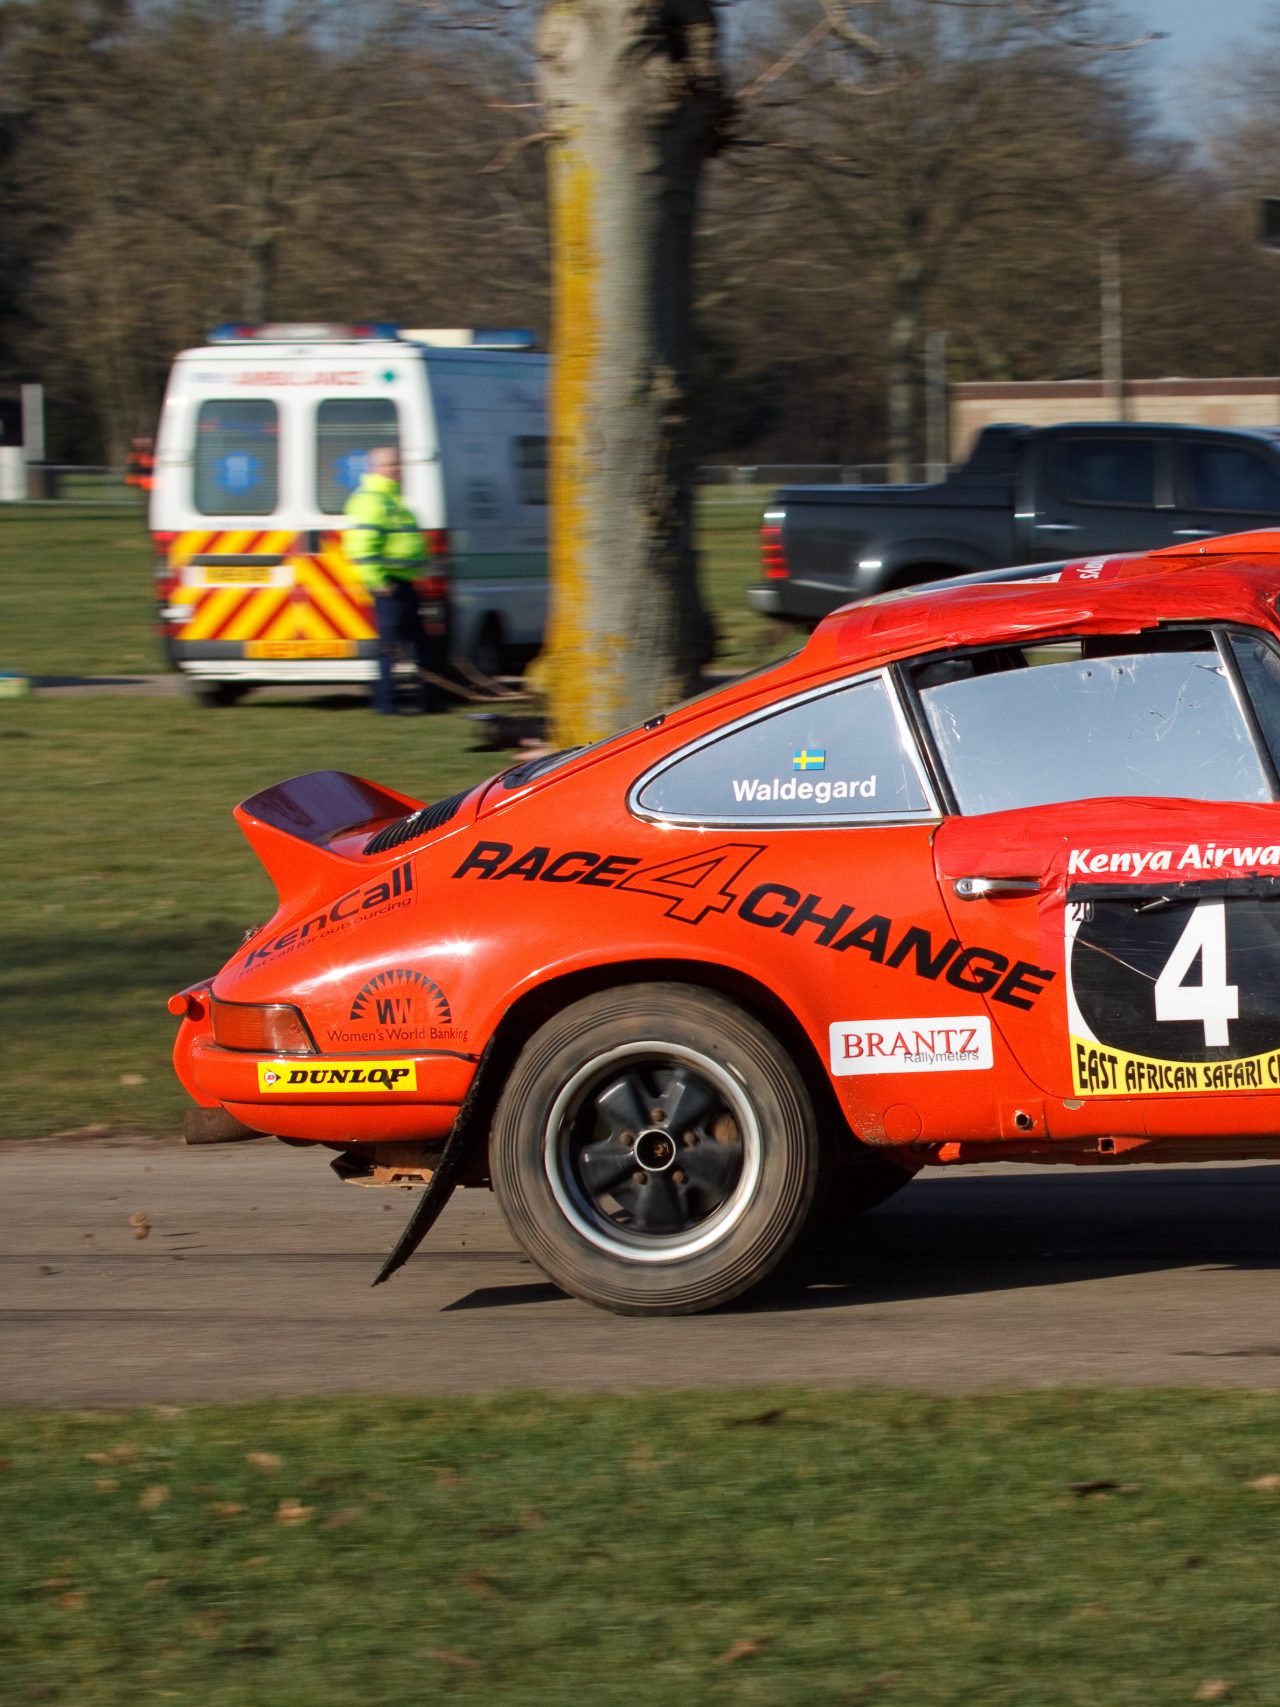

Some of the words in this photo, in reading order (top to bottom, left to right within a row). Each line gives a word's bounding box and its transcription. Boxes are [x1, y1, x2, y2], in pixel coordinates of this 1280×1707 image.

[733, 775, 876, 804] Waldegard
[1068, 848, 1172, 877] Kenya
[244, 861, 413, 969] KenCall
[1154, 897, 1239, 1046] 4
[327, 1029, 384, 1043] Women's
[386, 1027, 426, 1041] World
[430, 1027, 469, 1043] Banking
[841, 1028, 980, 1059] BRANTZ
[904, 1050, 979, 1066] Rallymeters
[1076, 1043, 1118, 1093] EAST
[1125, 1060, 1198, 1093] AFRICAN
[1204, 1058, 1263, 1090] SAFARI
[287, 1068, 410, 1084] DUNLOP
